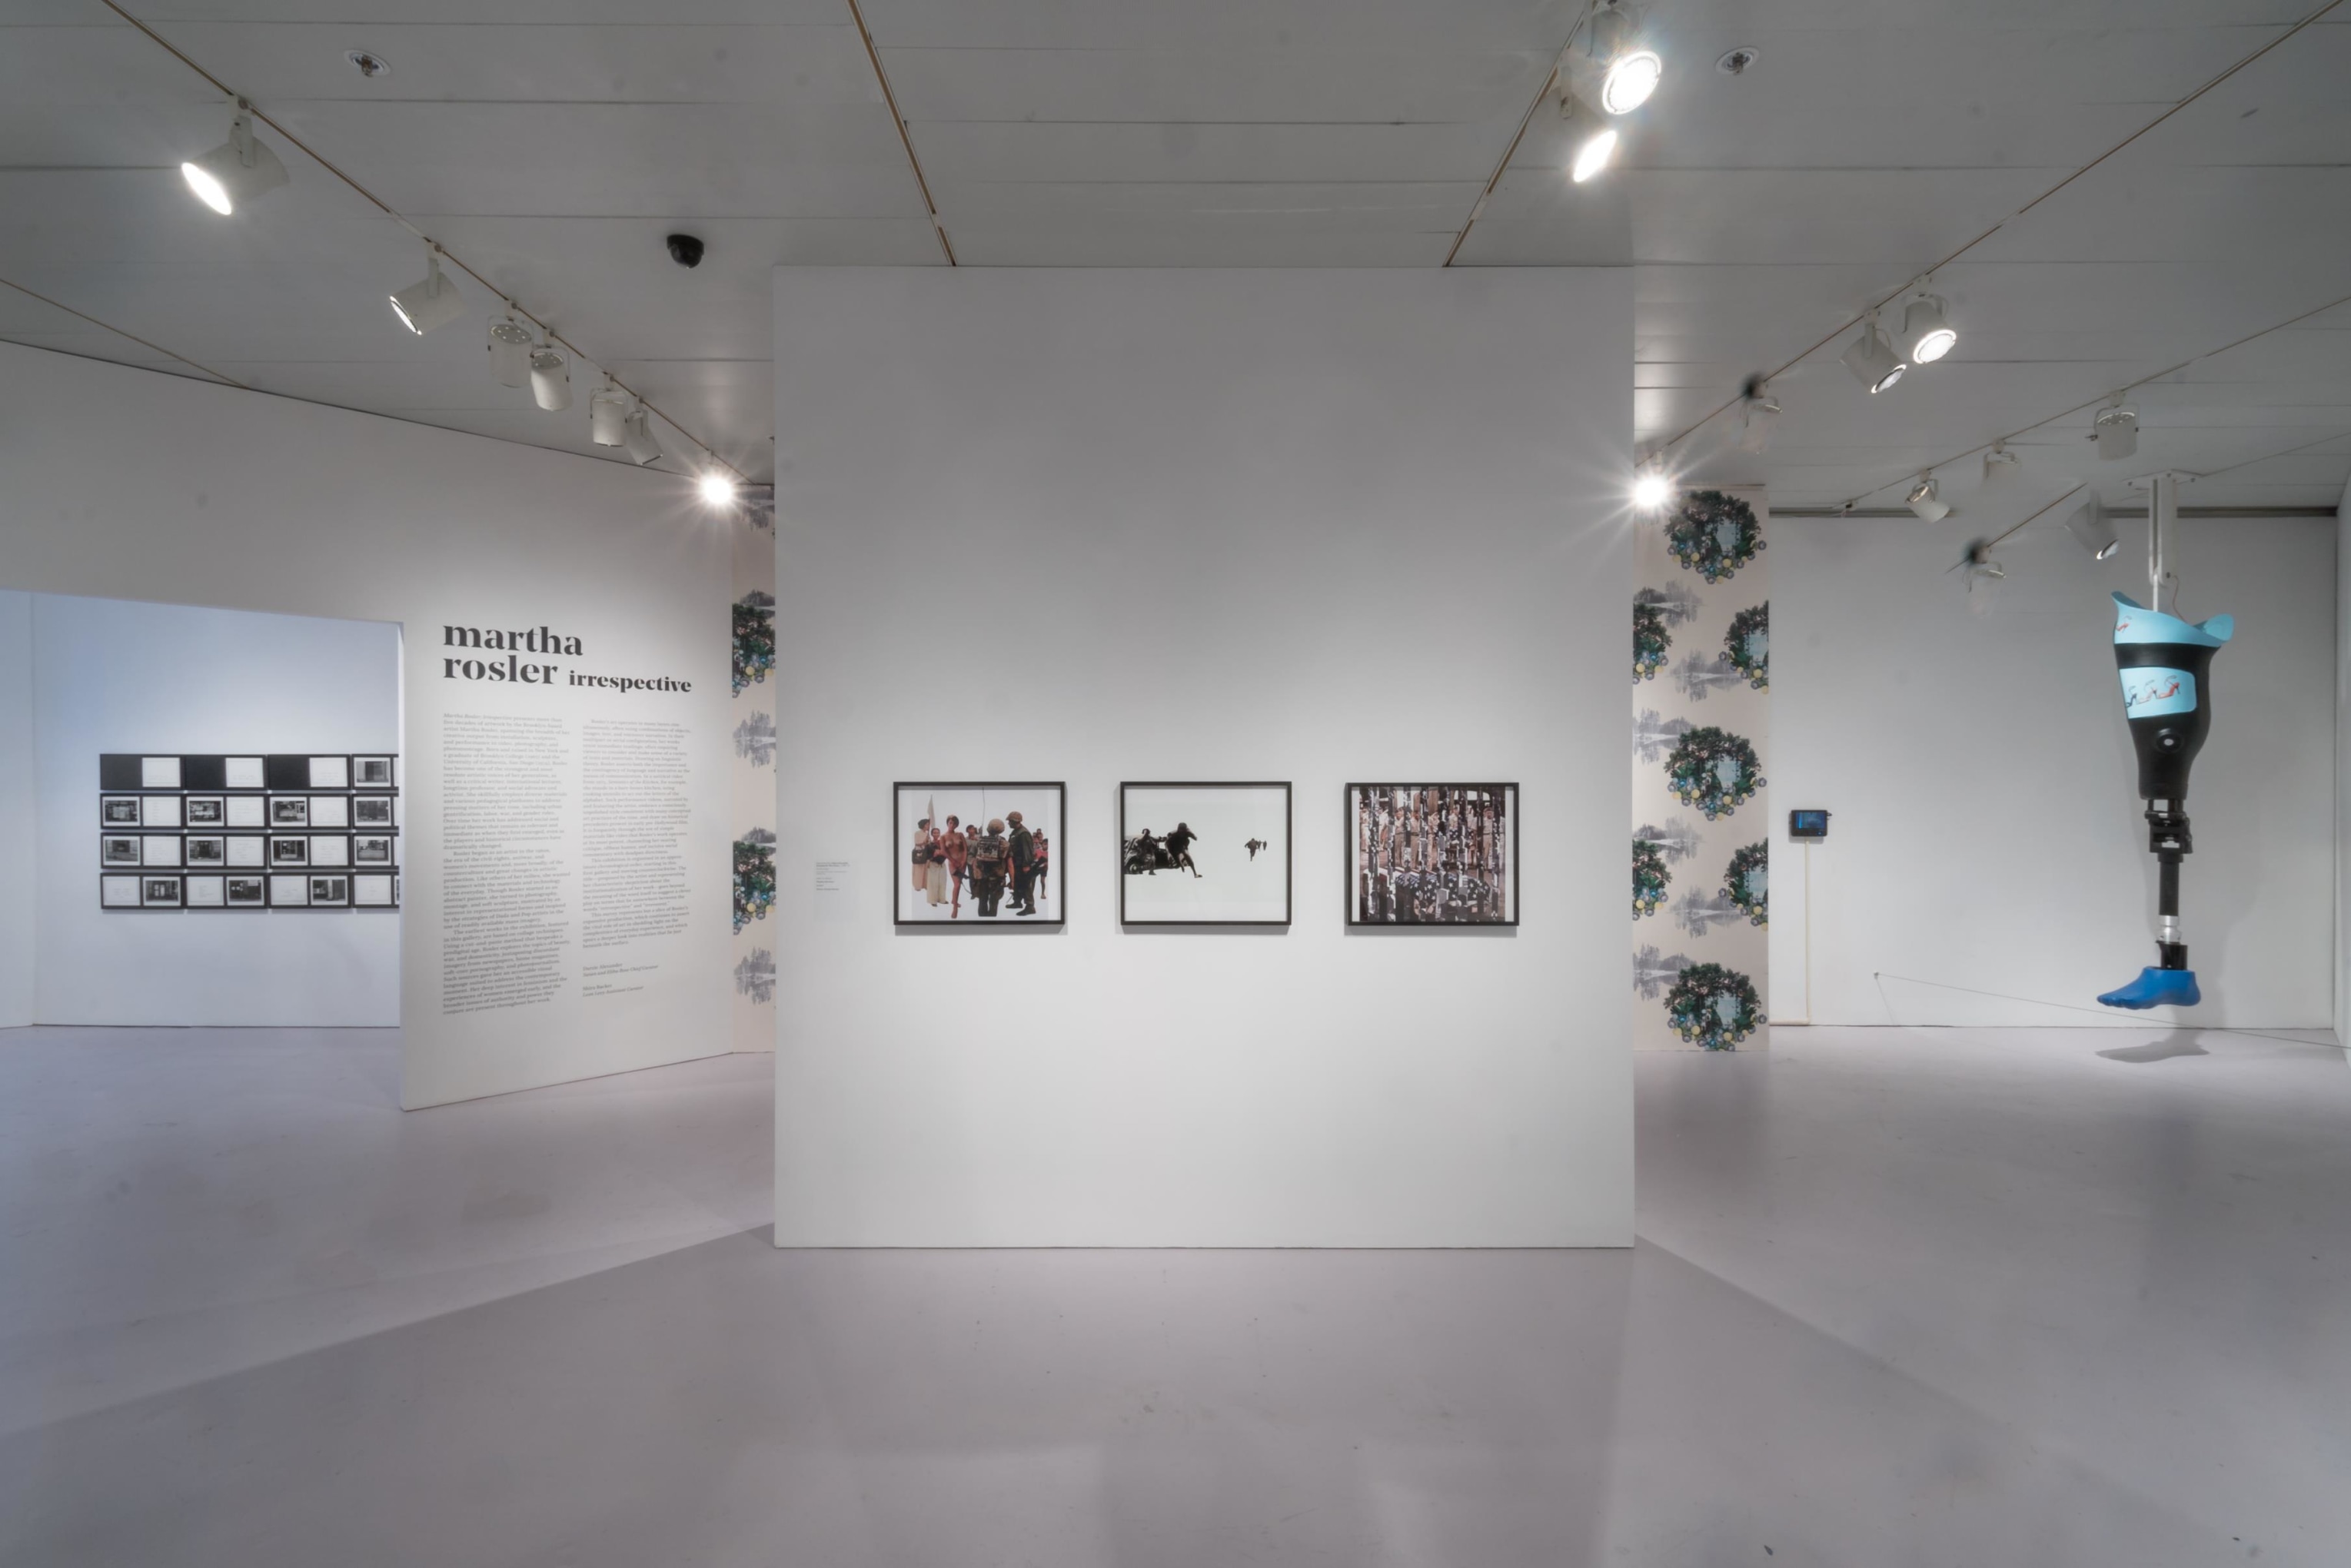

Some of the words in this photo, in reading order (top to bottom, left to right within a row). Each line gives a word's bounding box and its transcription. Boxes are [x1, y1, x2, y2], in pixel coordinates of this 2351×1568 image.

[443, 625, 584, 656] martha
[443, 655, 558, 684] rosler
[569, 669, 692, 693] irrespective
